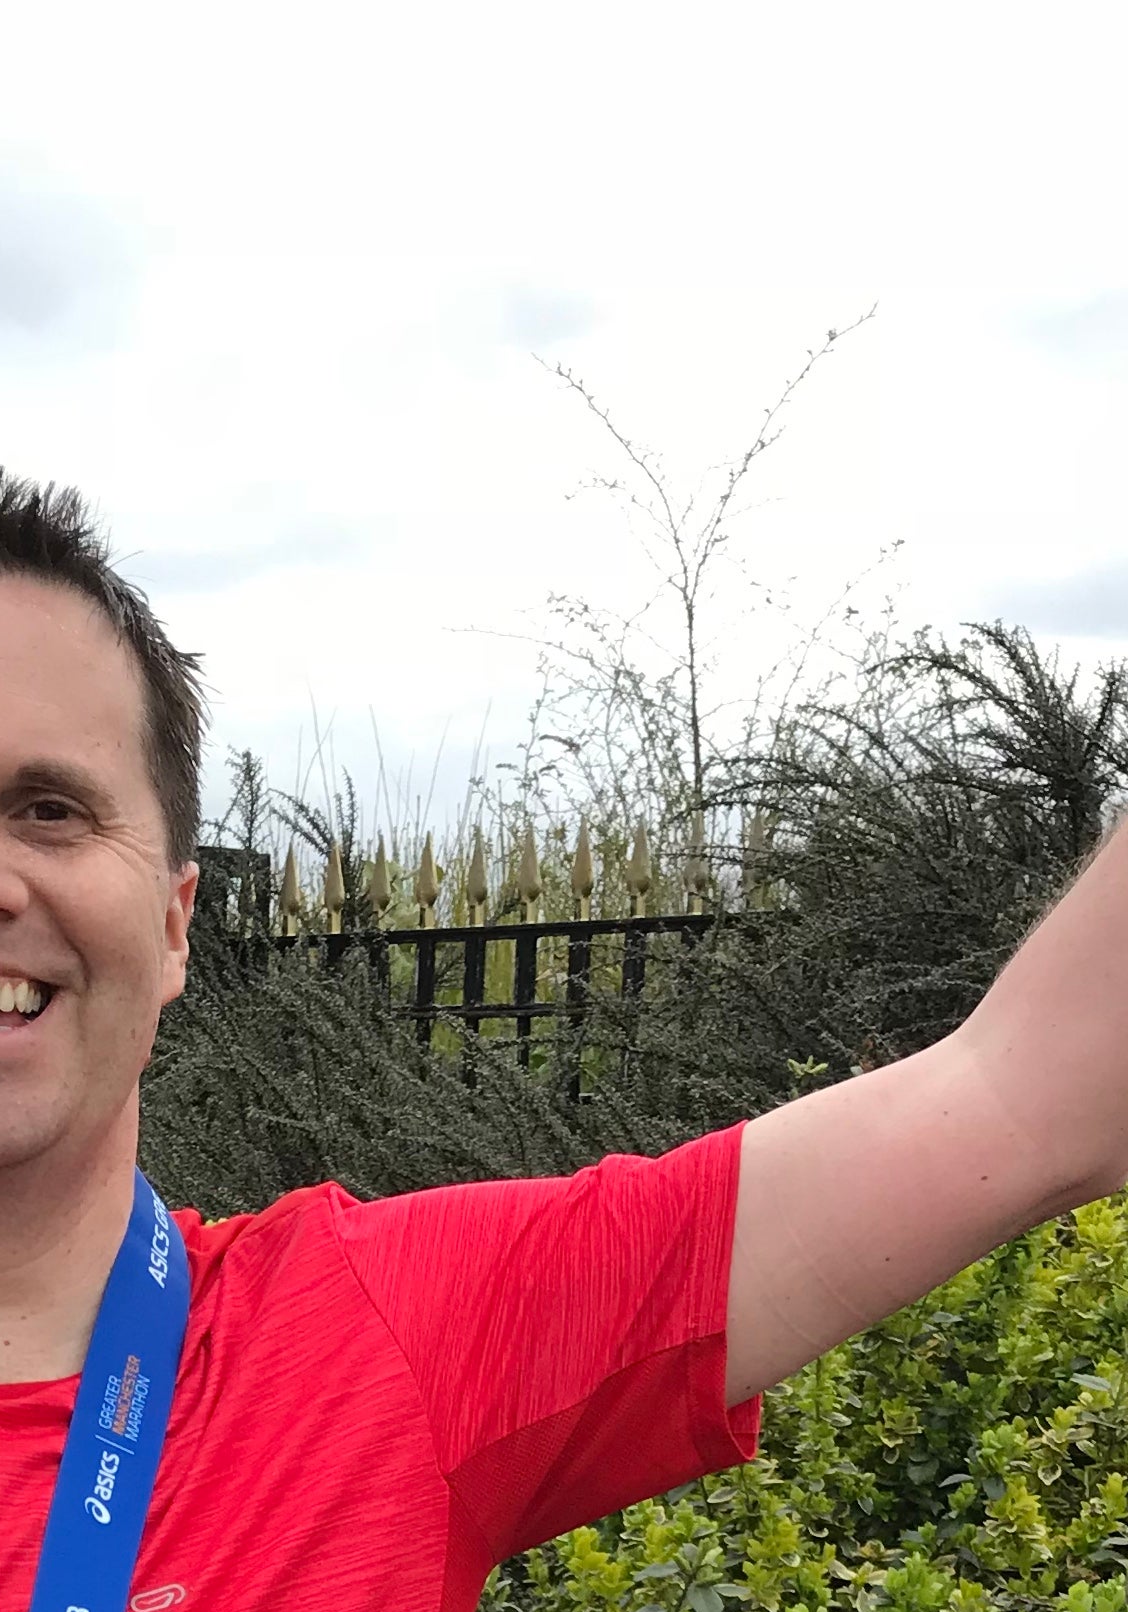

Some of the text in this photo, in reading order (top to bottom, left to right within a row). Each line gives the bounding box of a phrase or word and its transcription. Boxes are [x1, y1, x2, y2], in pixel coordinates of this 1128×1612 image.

[148, 1224, 170, 1289] ASICS
[98, 1375, 121, 1430] GREATER
[112, 1354, 141, 1436] MANCHESTER
[124, 1374, 151, 1442] MARATHON
[93, 1450, 120, 1502] asics
